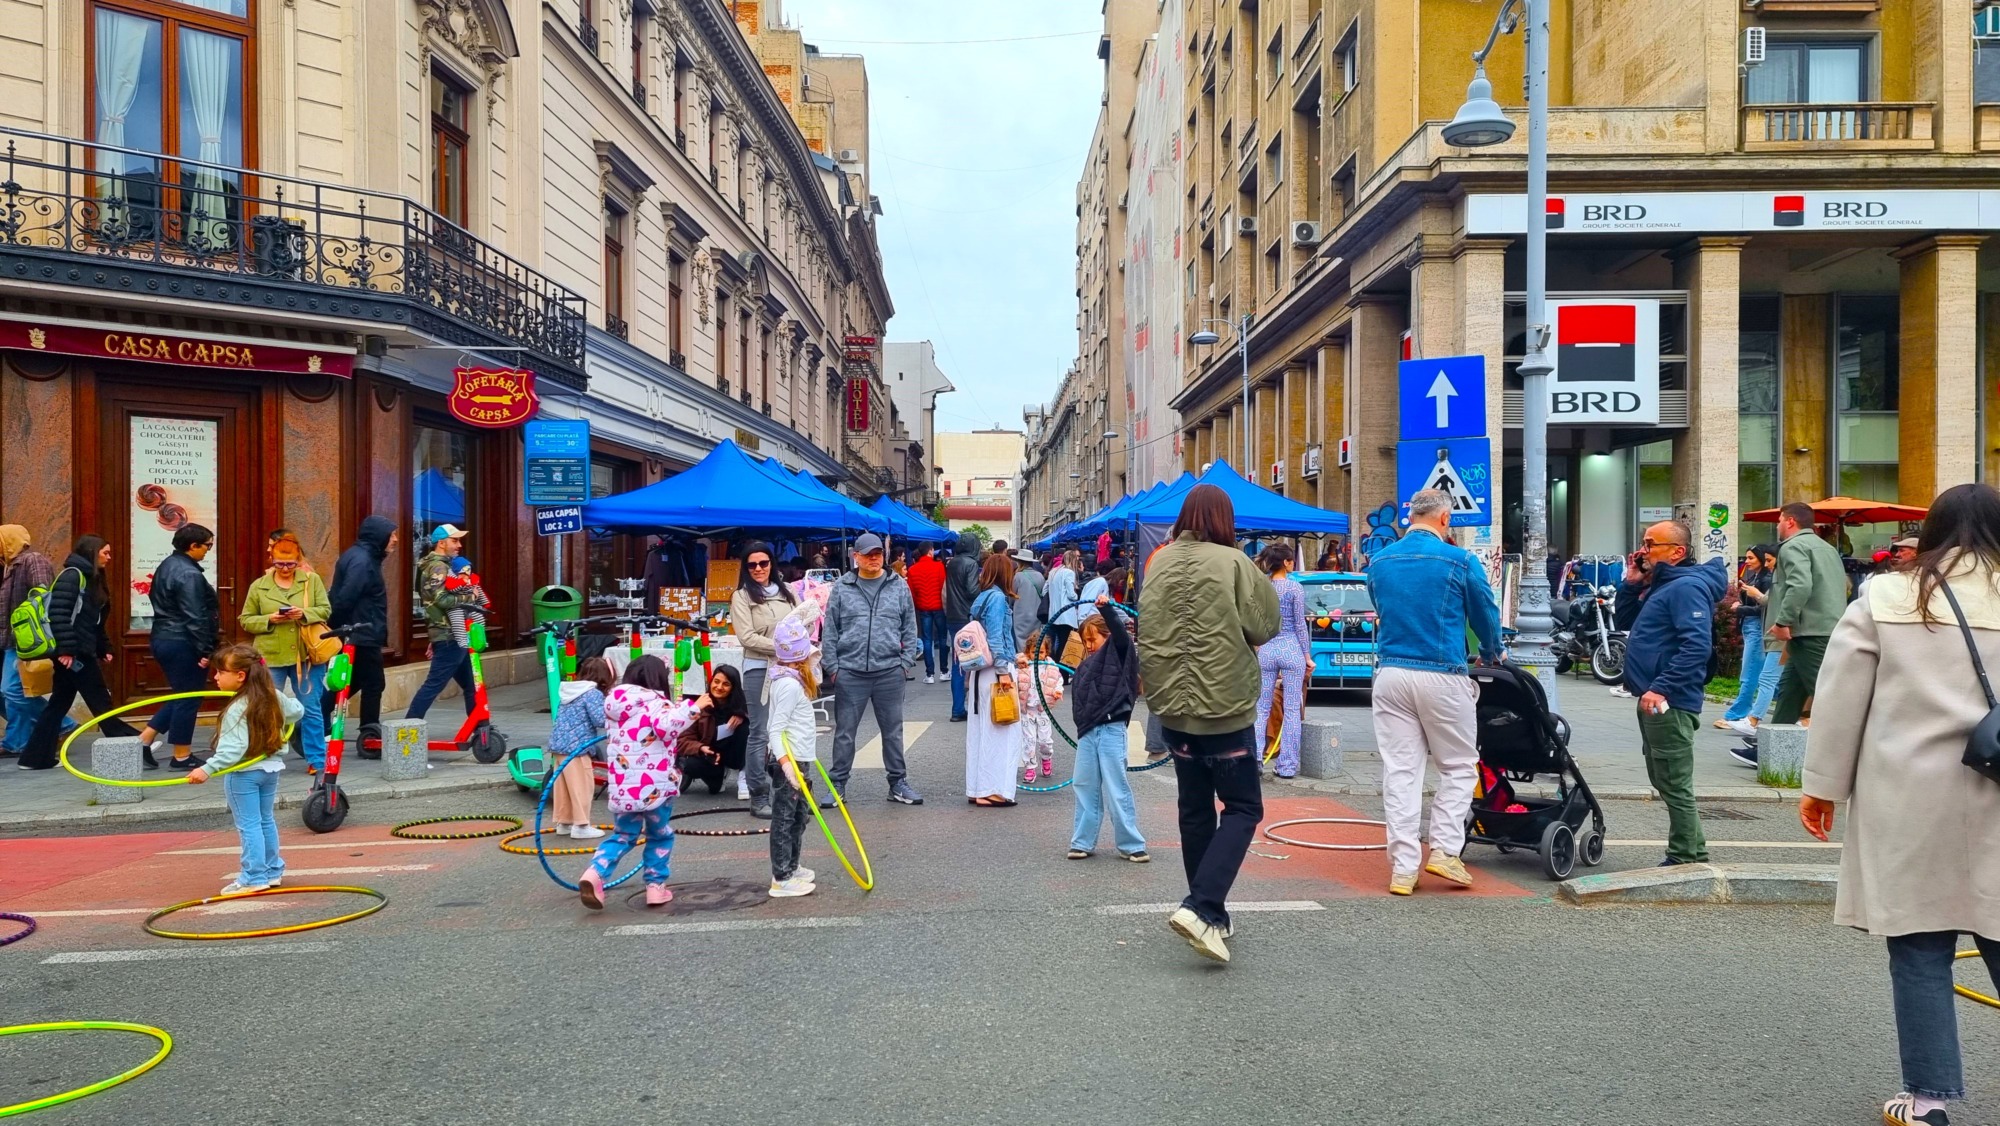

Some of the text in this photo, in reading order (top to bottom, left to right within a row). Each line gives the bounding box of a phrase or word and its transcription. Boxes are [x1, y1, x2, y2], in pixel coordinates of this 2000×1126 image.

[1583, 205, 1647, 221] BRD
[1823, 202, 1888, 218] BRD
[104, 333, 255, 368] CASA CAPSA
[852, 379, 862, 430] HOTEL
[1551, 391, 1641, 414] BRD
[154, 424, 177, 432] CASA
[140, 431, 206, 441] CHOCOLATERIE
[144, 448, 194, 458] BOMBOANE
[154, 477, 196, 486] DE POST
[538, 508, 578, 520] CASA CAPSA
[544, 522, 557, 531] LOC
[557, 522, 563, 530] 2
[568, 520, 573, 529] 8
[1321, 584, 1367, 592] CHAR
[1344, 654, 1355, 663] 59
